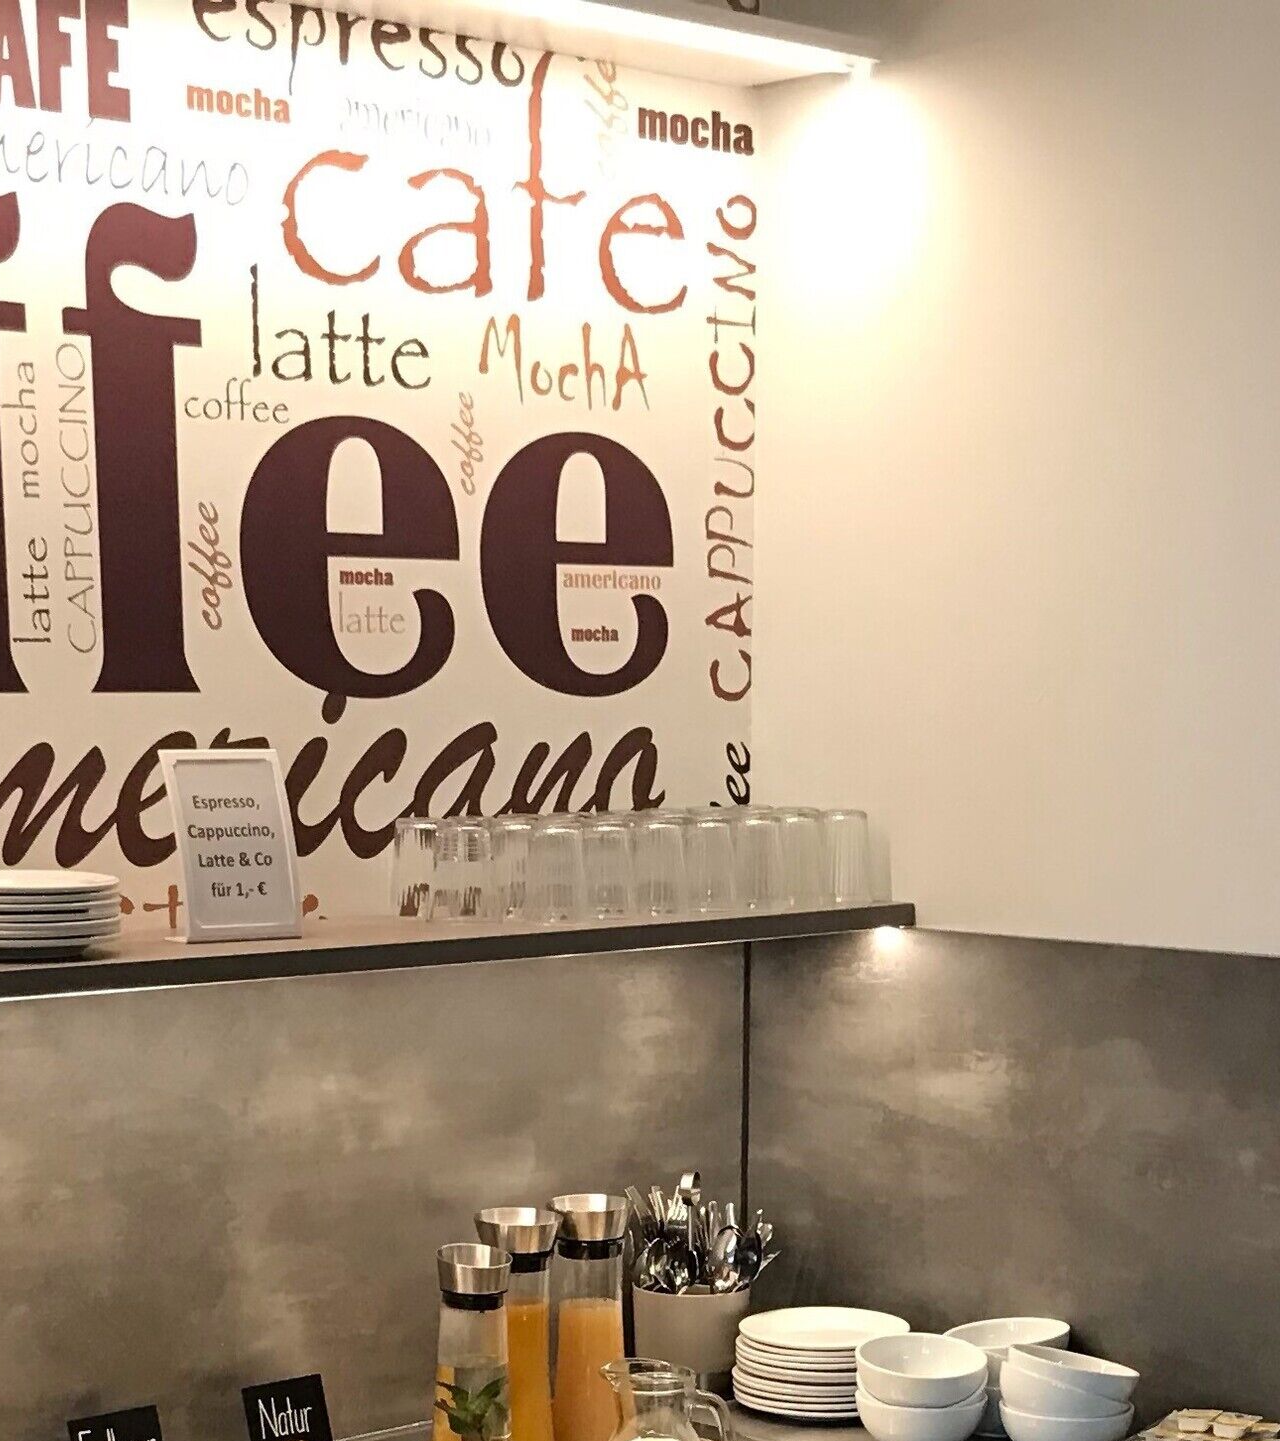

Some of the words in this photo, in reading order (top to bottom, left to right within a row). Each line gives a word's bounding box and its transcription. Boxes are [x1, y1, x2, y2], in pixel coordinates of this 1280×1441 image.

[187, 85, 291, 124] mocha
[638, 106, 754, 156] mocha
[281, 50, 688, 314] cafe
[250, 263, 431, 390] latte
[478, 313, 650, 412] MochA
[184, 377, 290, 425] coffee
[1, 360, 40, 500] mocha
[450, 391, 483, 496] coffee
[704, 194, 756, 701] CAPPUCCINO
[56, 343, 99, 655] CAPPUCCINO
[188, 500, 232, 630] coffee
[339, 568, 394, 586] mocha
[562, 568, 662, 591] americano
[13, 536, 53, 646] latte
[338, 591, 407, 636] latte
[571, 626, 620, 643] mocha
[192, 795, 260, 812] Espresso,
[187, 823, 275, 841] Cappuccino,
[198, 853, 235, 868] Latte
[239, 852, 251, 867] &
[254, 851, 273, 867] Co
[211, 881, 232, 898] für
[257, 881, 268, 896] €
[258, 1398, 312, 1439] Natur
